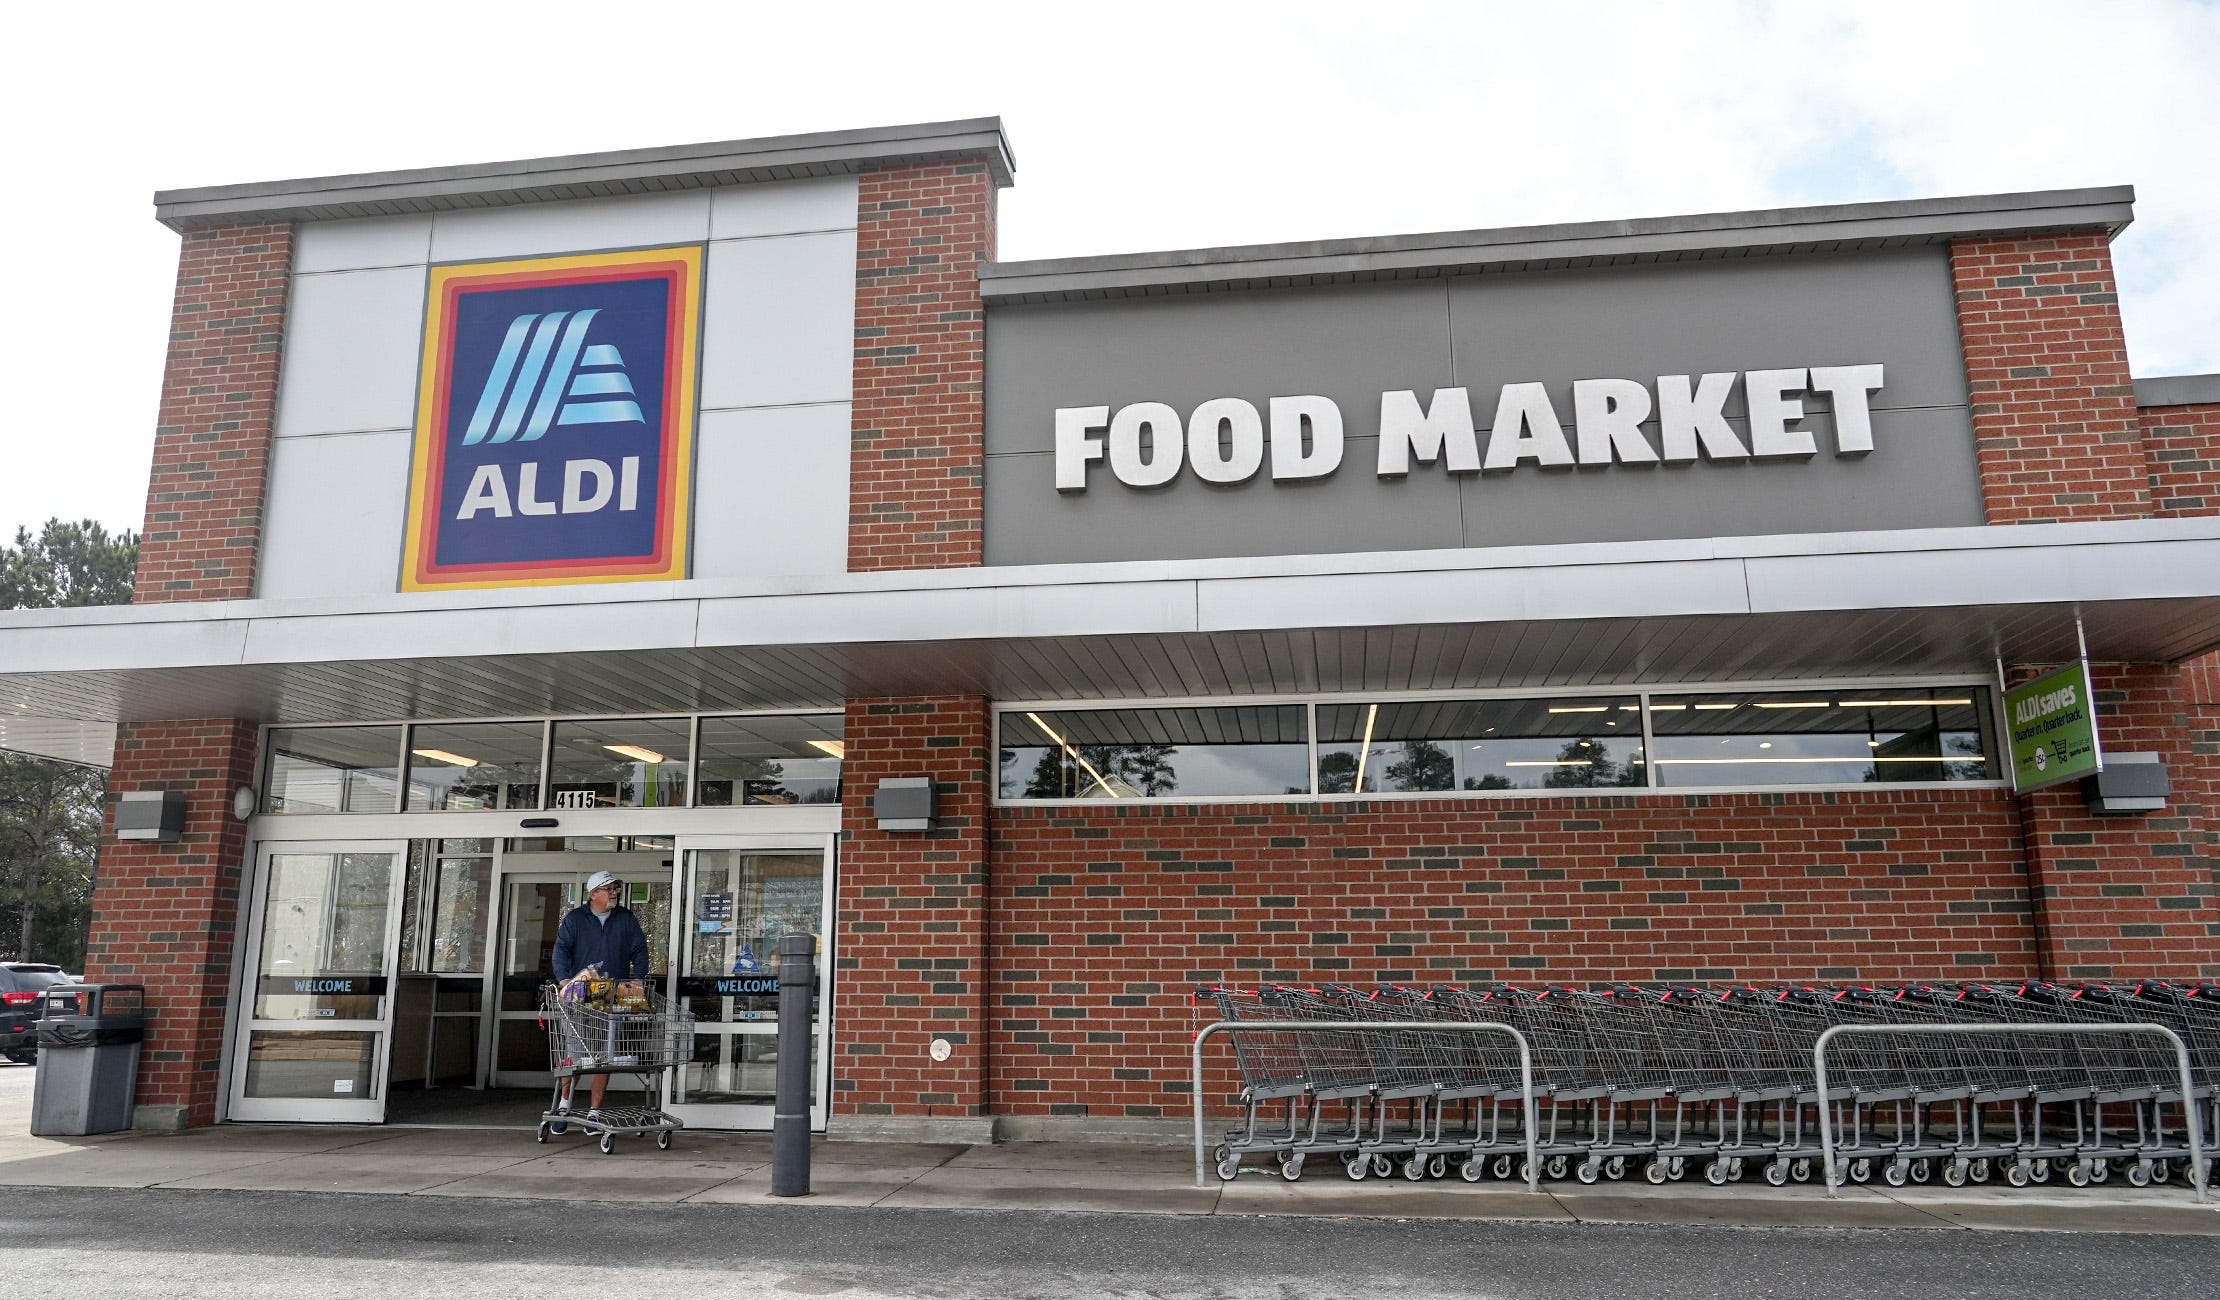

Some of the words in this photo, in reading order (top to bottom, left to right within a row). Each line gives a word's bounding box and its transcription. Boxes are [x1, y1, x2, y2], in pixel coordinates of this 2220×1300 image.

[1055, 395, 1344, 494] FOOD
[1376, 363, 1884, 480] MARKET
[456, 456, 639, 519] ALDI
[2016, 694, 2041, 725] ALDI
[2041, 685, 2076, 715] saves
[2043, 714, 2066, 733] Quarter
[557, 791, 594, 809] 4115
[294, 980, 352, 992] WELCOME
[717, 980, 780, 992] WELCOME
